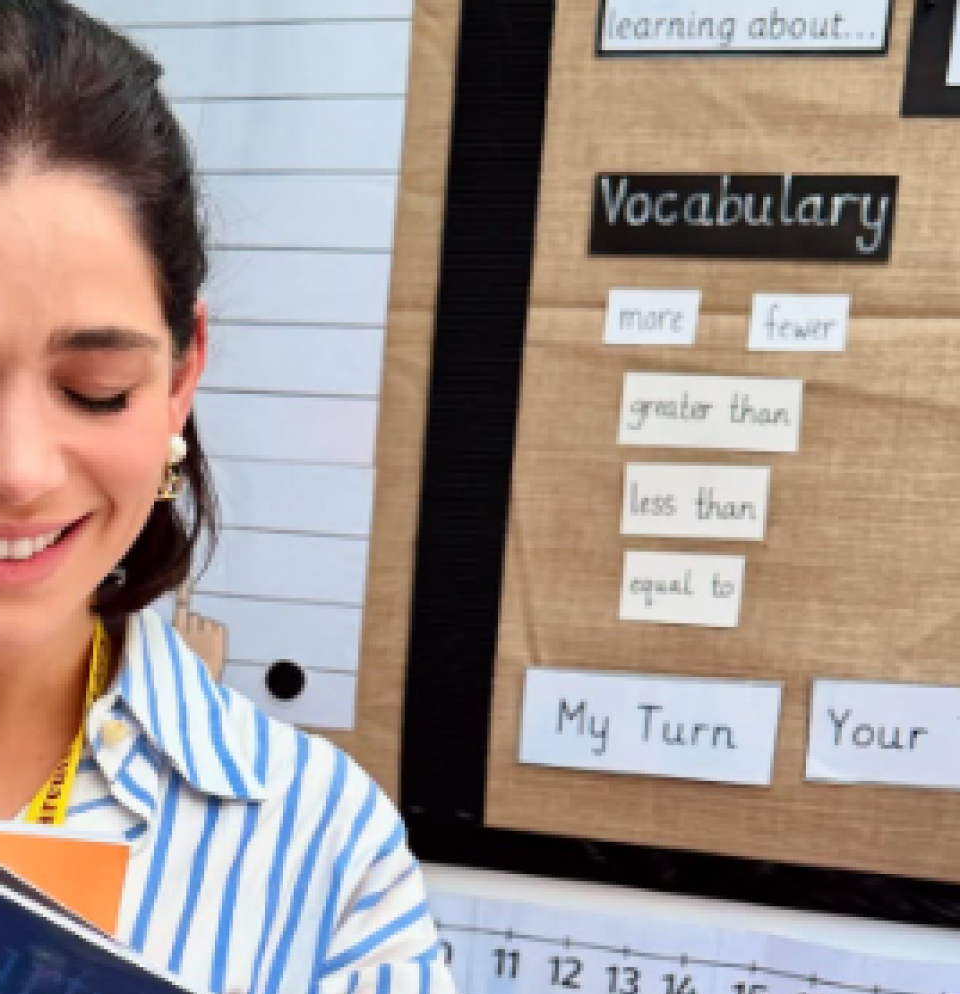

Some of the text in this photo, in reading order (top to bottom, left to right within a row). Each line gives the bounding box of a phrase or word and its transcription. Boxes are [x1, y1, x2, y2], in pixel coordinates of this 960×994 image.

[607, 7, 876, 48] learning about...
[600, 174, 890, 255] Vocabulary
[618, 308, 685, 333] more
[763, 302, 838, 341] fewer
[626, 390, 792, 431] greater than
[629, 480, 757, 521] less than
[629, 568, 736, 609] equal to
[554, 696, 739, 757] My Turn
[826, 706, 930, 751] Your
[492, 948, 520, 979] 11
[548, 955, 584, 990] 12
